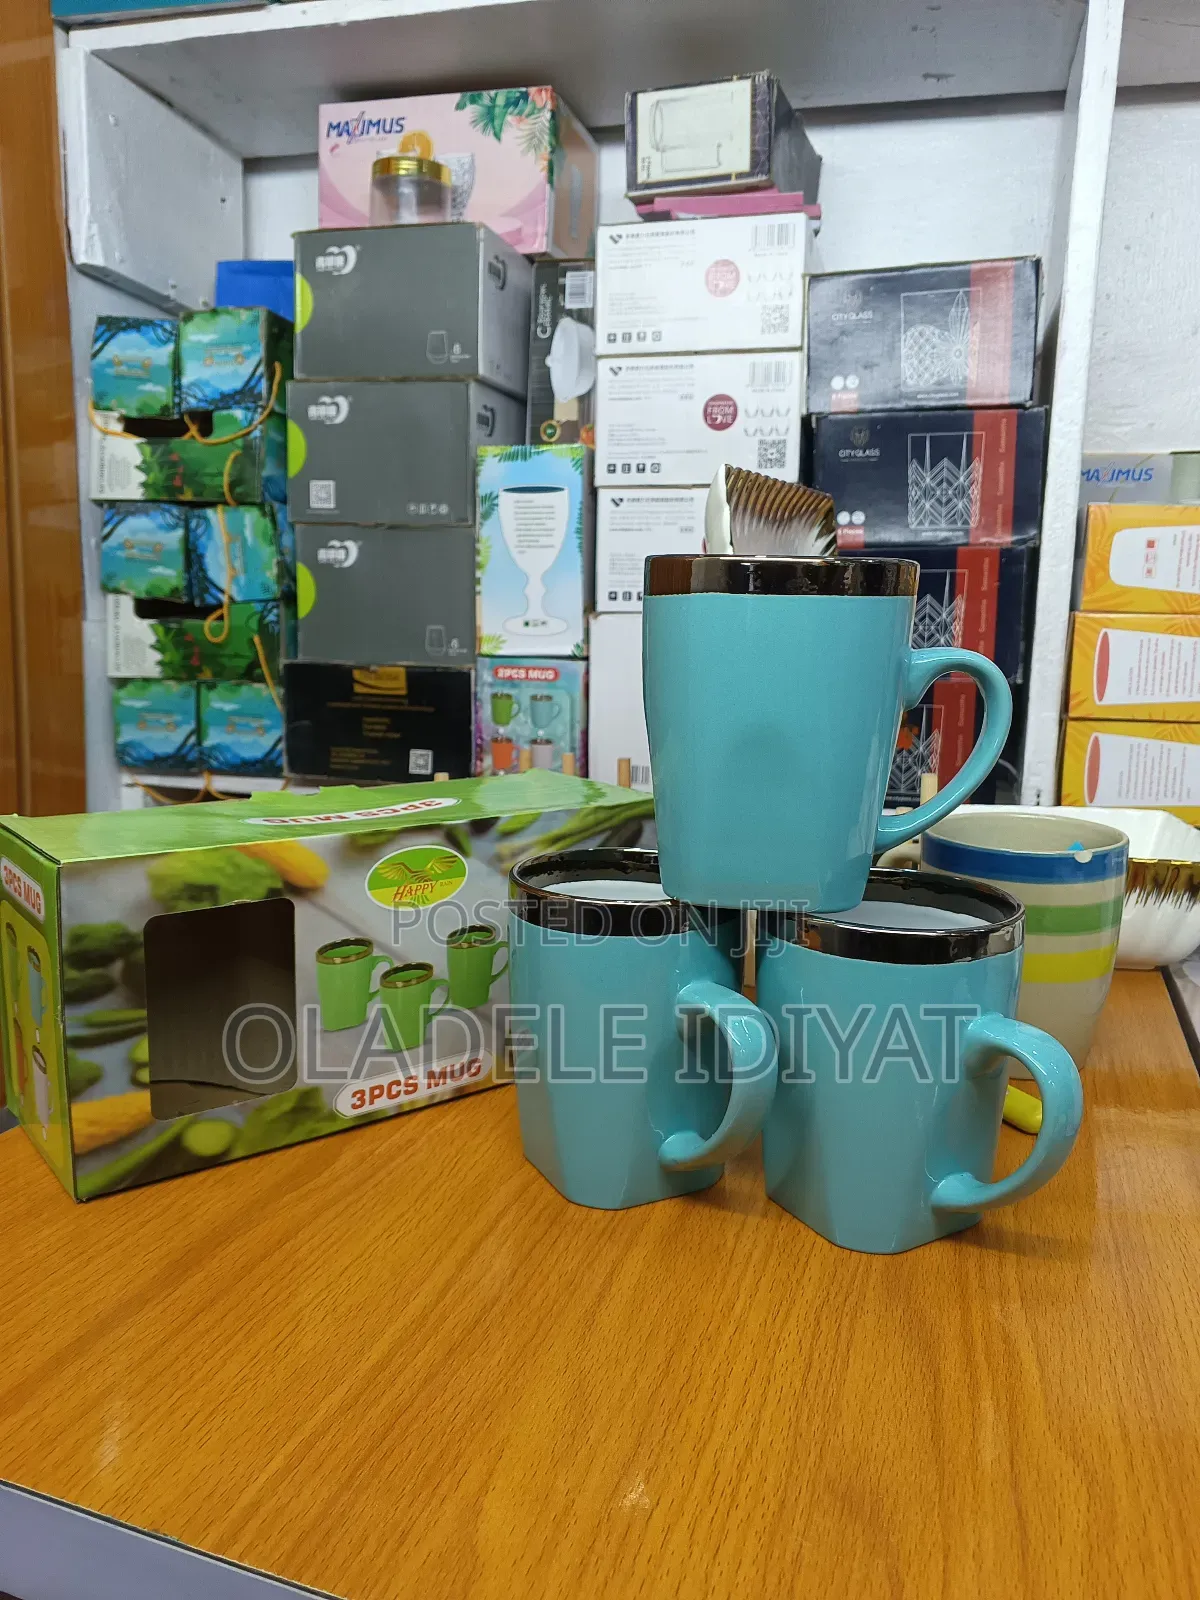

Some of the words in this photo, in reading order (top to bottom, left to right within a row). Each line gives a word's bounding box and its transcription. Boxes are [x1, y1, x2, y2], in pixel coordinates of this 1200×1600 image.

[326, 111, 406, 145] MAXIMUS
[707, 405, 735, 415] FROM
[527, 669, 555, 680] MUG
[354, 799, 443, 817] 3PCS
[262, 814, 349, 824] MUG
[3, 865, 22, 898] 3PCS
[23, 881, 42, 915] MUG
[393, 880, 439, 903] HAPPY
[351, 1075, 419, 1110] 3PCS
[426, 1057, 482, 1090] MUG
